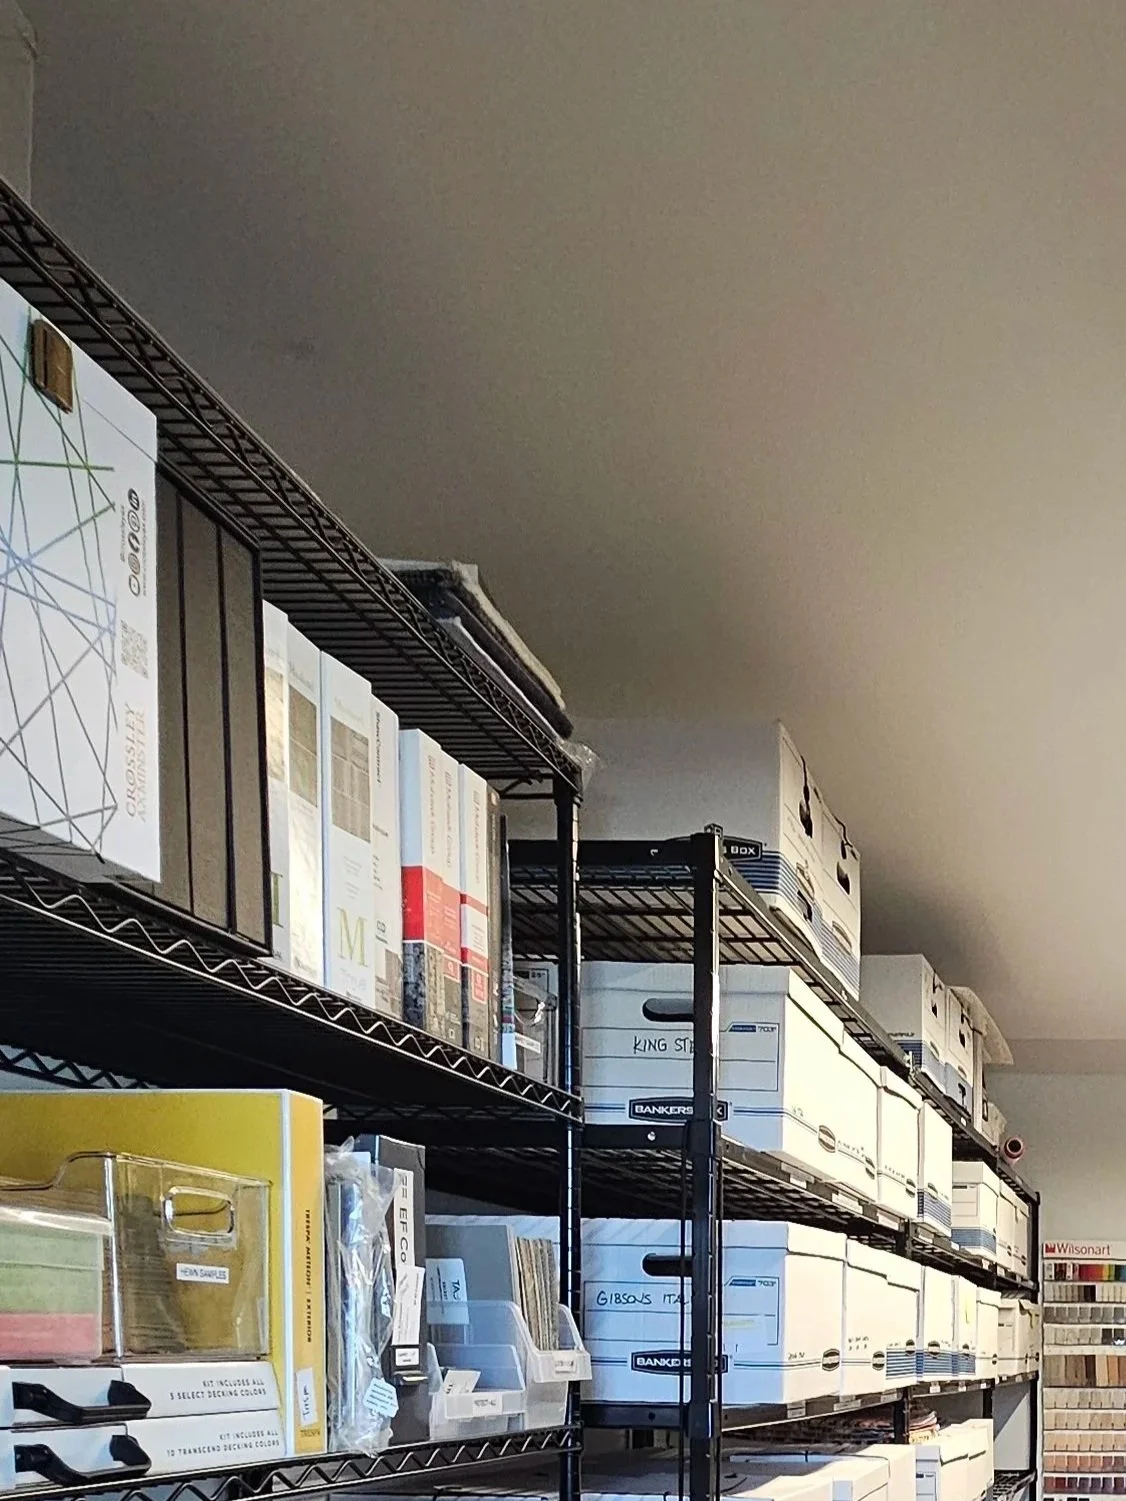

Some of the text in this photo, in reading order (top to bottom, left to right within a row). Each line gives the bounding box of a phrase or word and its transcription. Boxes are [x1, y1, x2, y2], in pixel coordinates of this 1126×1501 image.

[125, 703, 138, 818] CROSSLEY
[730, 846, 756, 855] BOX
[634, 1035, 667, 1055] KING
[634, 1105, 694, 1115] BANKERS
[1056, 1242, 1111, 1257] Wilsonart
[596, 1291, 652, 1305] GIBSONS
[217, 1378, 250, 1387] INCLUDES
[252, 1378, 265, 1386] ALL
[177, 1391, 205, 1400] SELECT
[208, 1389, 239, 1398] DECKING
[240, 1388, 267, 1397] COLORS
[233, 1430, 264, 1439] INCLUDES
[178, 1445, 221, 1456] TRANSCEND
[224, 1442, 253, 1452] DECKING
[255, 1440, 280, 1448] COLORS
